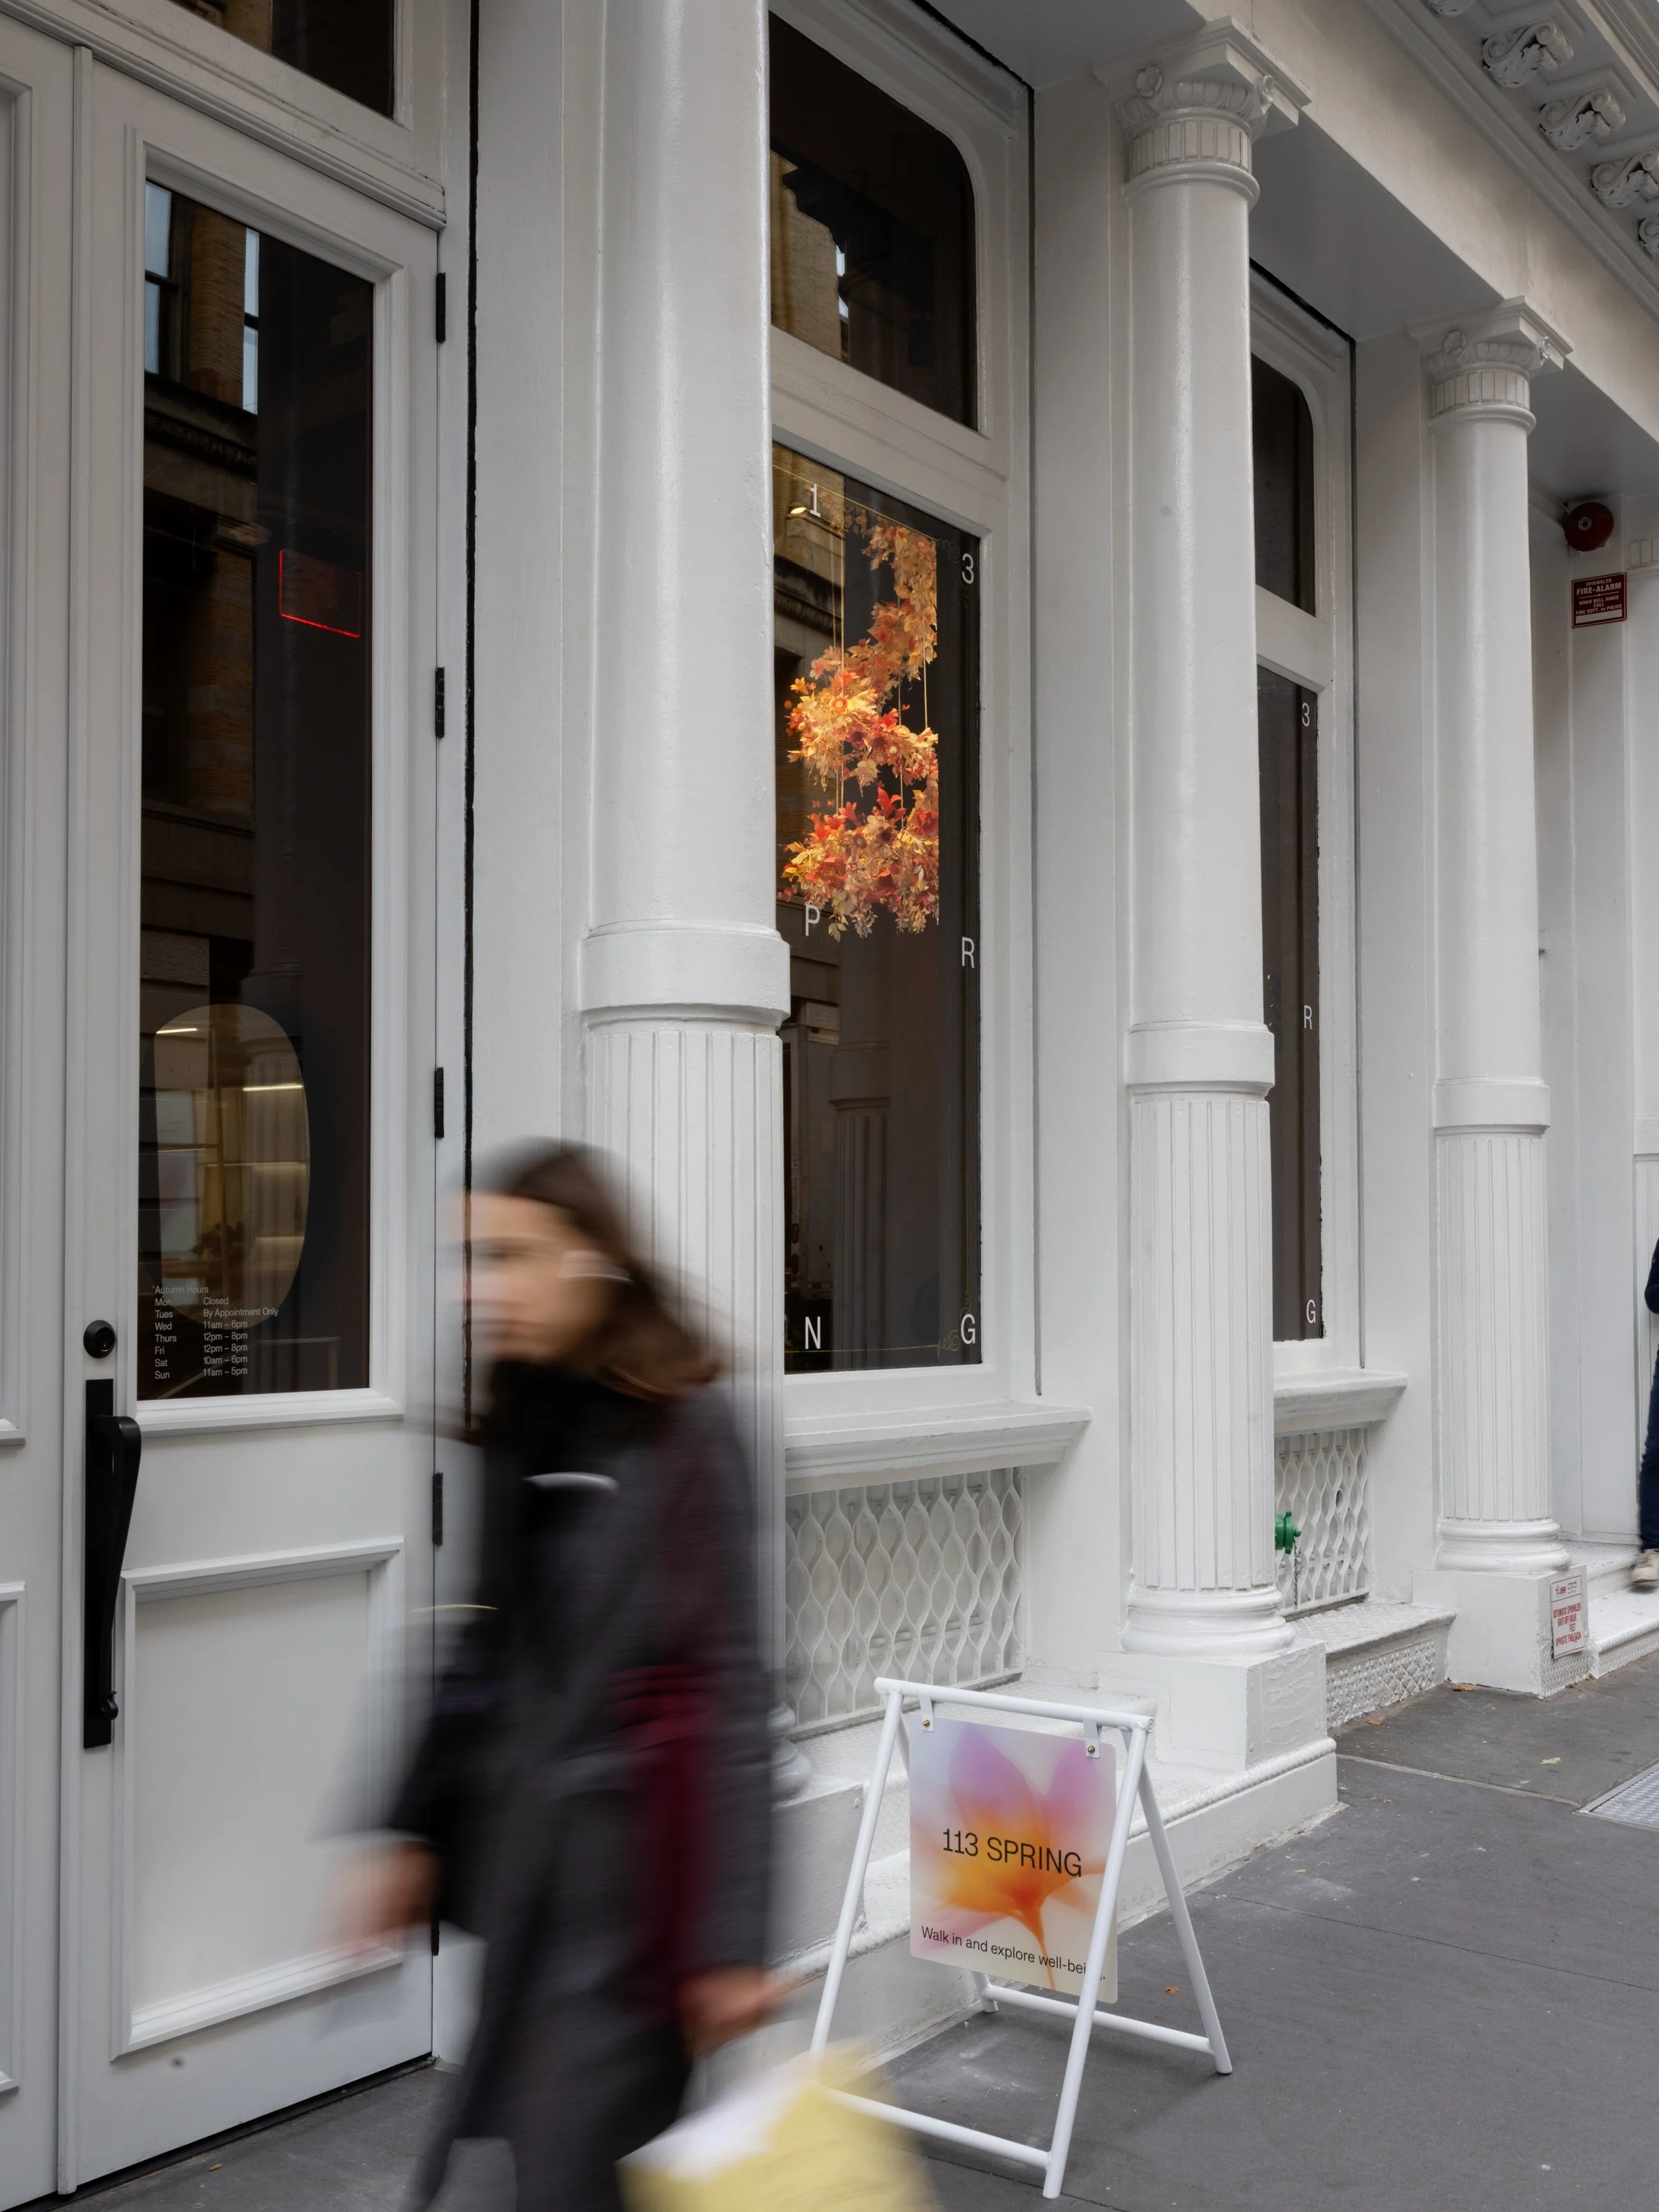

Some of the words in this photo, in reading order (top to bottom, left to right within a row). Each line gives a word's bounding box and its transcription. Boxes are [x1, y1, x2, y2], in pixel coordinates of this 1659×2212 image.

[809, 483, 821, 518] 1
[962, 553, 974, 584] 3
[1577, 582, 1622, 595] FIRE-ALARM
[1302, 702, 1309, 727] 3
[805, 904, 821, 937] P
[962, 937, 975, 968] R
[1304, 1005, 1313, 1029] R
[187, 1285, 209, 1293] Hours
[203, 1297, 229, 1305] Closed
[203, 1309, 214, 1318] By
[215, 1308, 261, 1318] Appointment
[262, 1307, 279, 1317] Only
[1306, 1300, 1316, 1323] G
[155, 1322, 171, 1331] Wed
[232, 1320, 247, 1329] 6pm
[805, 1316, 821, 1349] N
[961, 1313, 975, 1344] G
[155, 1334, 177, 1342] Thurs
[203, 1333, 223, 1342] 12pm
[232, 1332, 247, 1341] 8pm
[155, 1347, 165, 1355] Fri
[203, 1344, 223, 1354] 12pm
[232, 1344, 247, 1353] 8pm
[203, 1356, 223, 1365] 10am
[232, 1356, 247, 1365] 6pm
[155, 1371, 170, 1379] Sun
[232, 1367, 247, 1376] 5pm
[942, 1828, 978, 1856] 113
[987, 1837, 1082, 1877] SPRING
[921, 1925, 949, 1944] Walk
[952, 1933, 962, 1947] in
[966, 1938, 988, 1953] and
[991, 1945, 1035, 1963] explore
[1038, 1954, 1105, 1982] well-bei.
